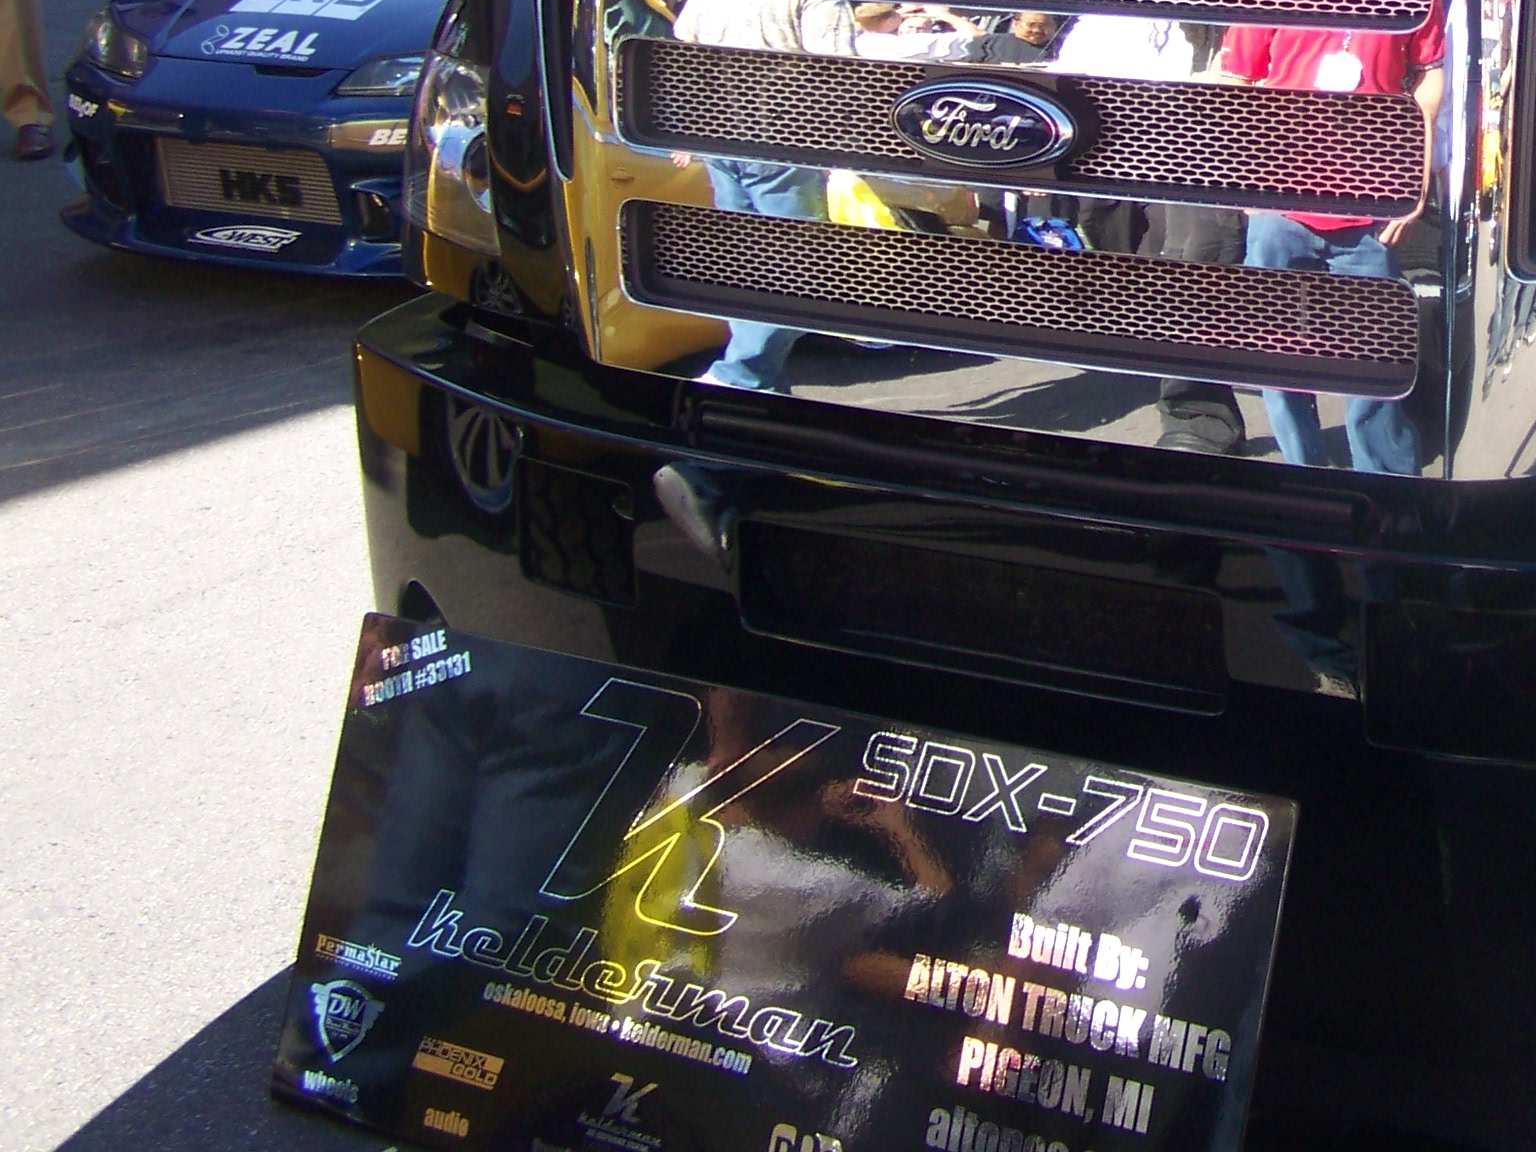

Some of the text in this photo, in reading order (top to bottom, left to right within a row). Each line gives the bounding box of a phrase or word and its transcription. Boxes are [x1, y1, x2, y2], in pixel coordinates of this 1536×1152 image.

[221, 26, 320, 56] ZEAL
[922, 96, 1020, 150] Ford
[219, 169, 303, 207] HKS
[382, 629, 448, 671] FOR SALE
[363, 651, 472, 707] BOOTH #33131
[853, 731, 1270, 881] SDX-750
[1008, 912, 1149, 990] Built By:
[483, 979, 566, 1022] oskaloosa,
[620, 1016, 753, 1075] kelderman.com
[904, 953, 1232, 1083] ALTON TRUCK MFG
[419, 1036, 487, 1068] PHOENIX
[451, 1062, 499, 1086] GOLD
[303, 1070, 359, 1104] wheels
[956, 1036, 1155, 1135] PIGEON, MI
[424, 1107, 470, 1138] audio
